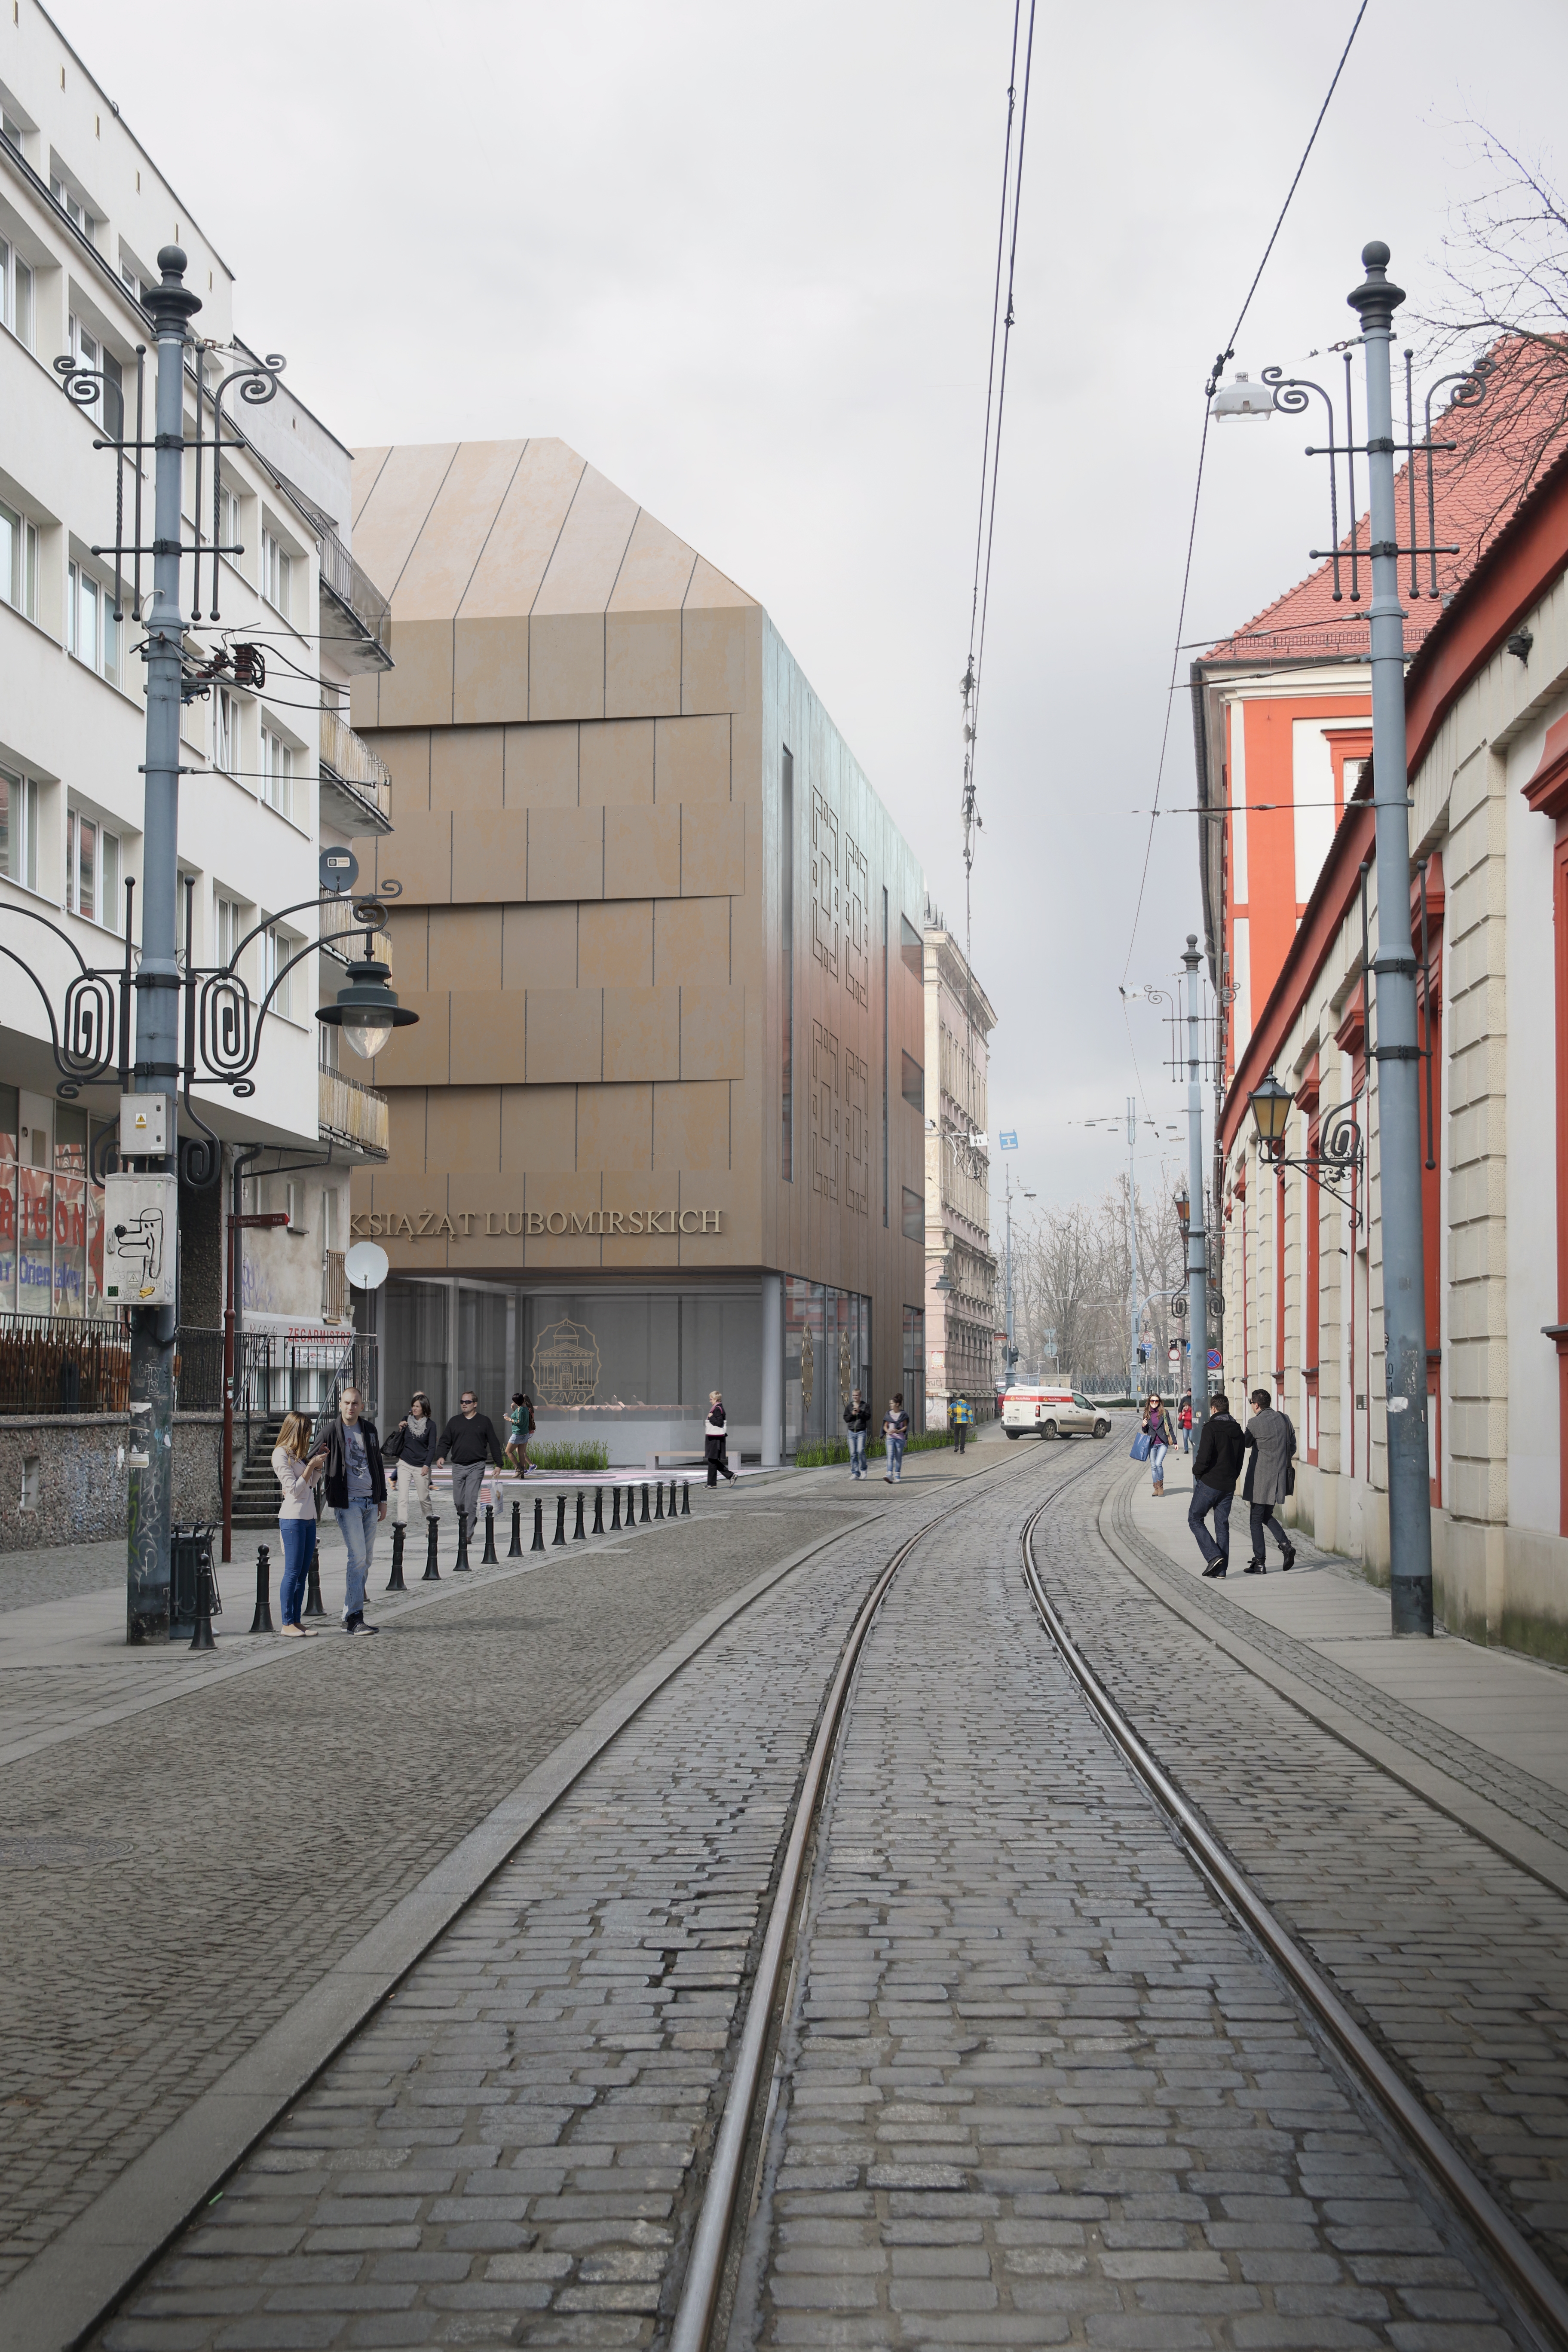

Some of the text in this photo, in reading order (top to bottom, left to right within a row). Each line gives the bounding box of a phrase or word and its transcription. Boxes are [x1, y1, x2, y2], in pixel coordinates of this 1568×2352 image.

[350, 1207, 723, 1242] KSIĄŻĄT LUBOMIRSKICH
[20, 1256, 81, 1297] Orientalny
[288, 1327, 351, 1345] ZEGARMISTRZ
